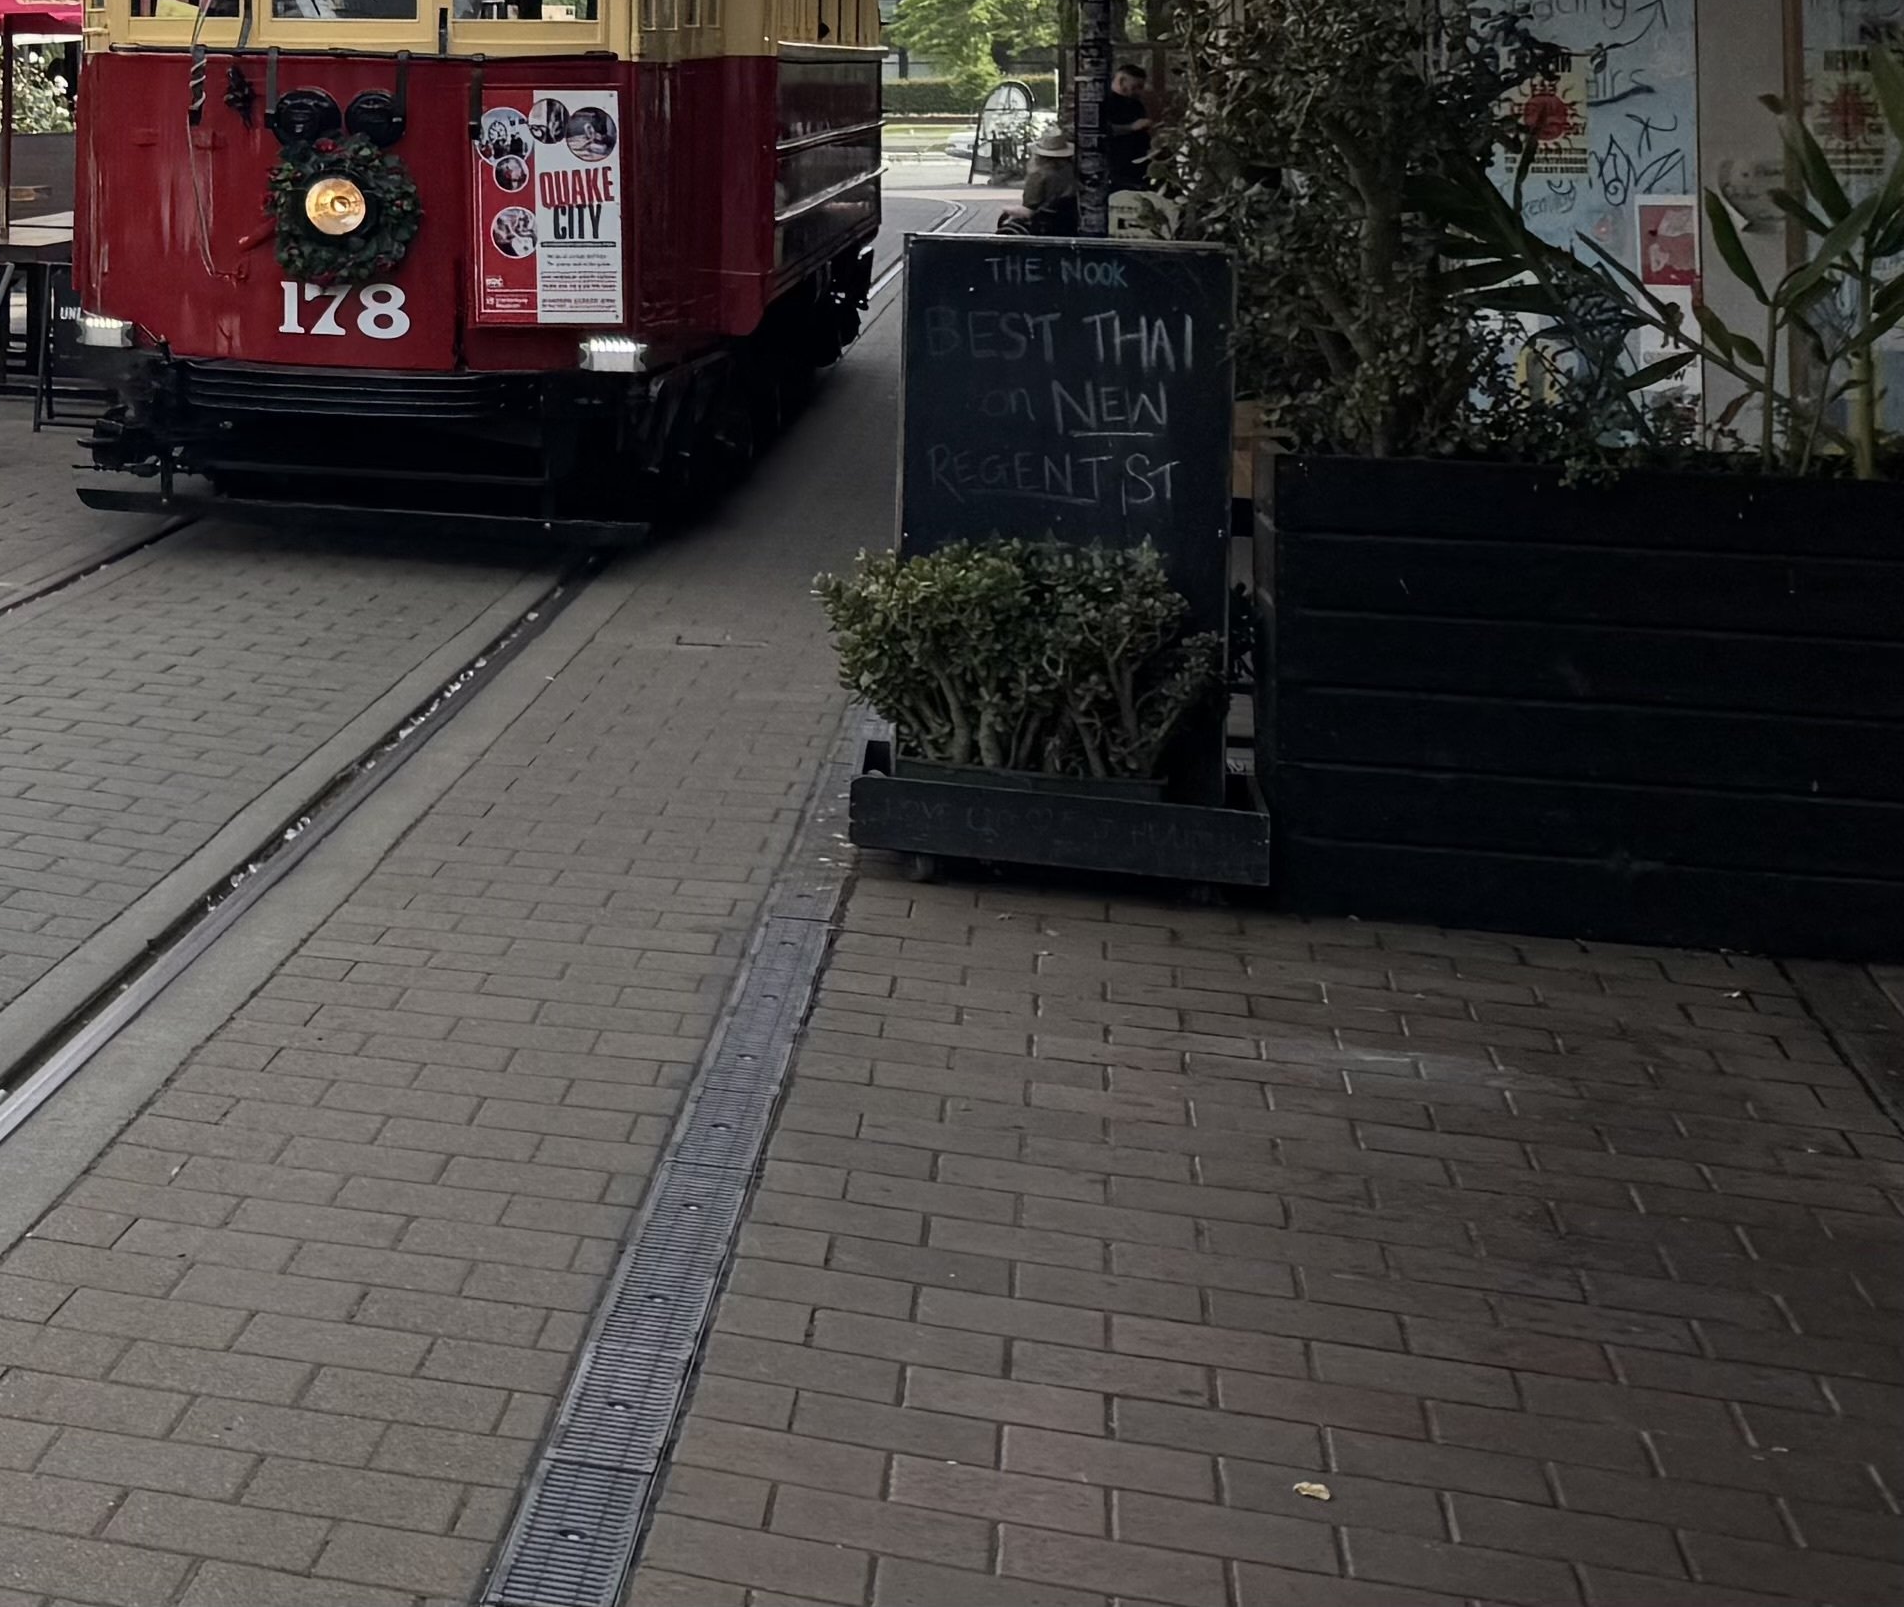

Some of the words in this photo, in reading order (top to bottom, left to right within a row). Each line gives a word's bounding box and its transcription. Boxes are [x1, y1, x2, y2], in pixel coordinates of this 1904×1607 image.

[539, 165, 615, 211] QUAKE
[553, 203, 603, 240] CITY
[984, 257, 1044, 286] THE
[1059, 256, 1129, 289] NOOK
[278, 280, 411, 340] 178
[924, 305, 1063, 365] BEST
[1081, 308, 1194, 373] THAI
[1050, 379, 1170, 436] NEW
[927, 444, 1115, 504] REGENT
[1122, 451, 1182, 506] ST
